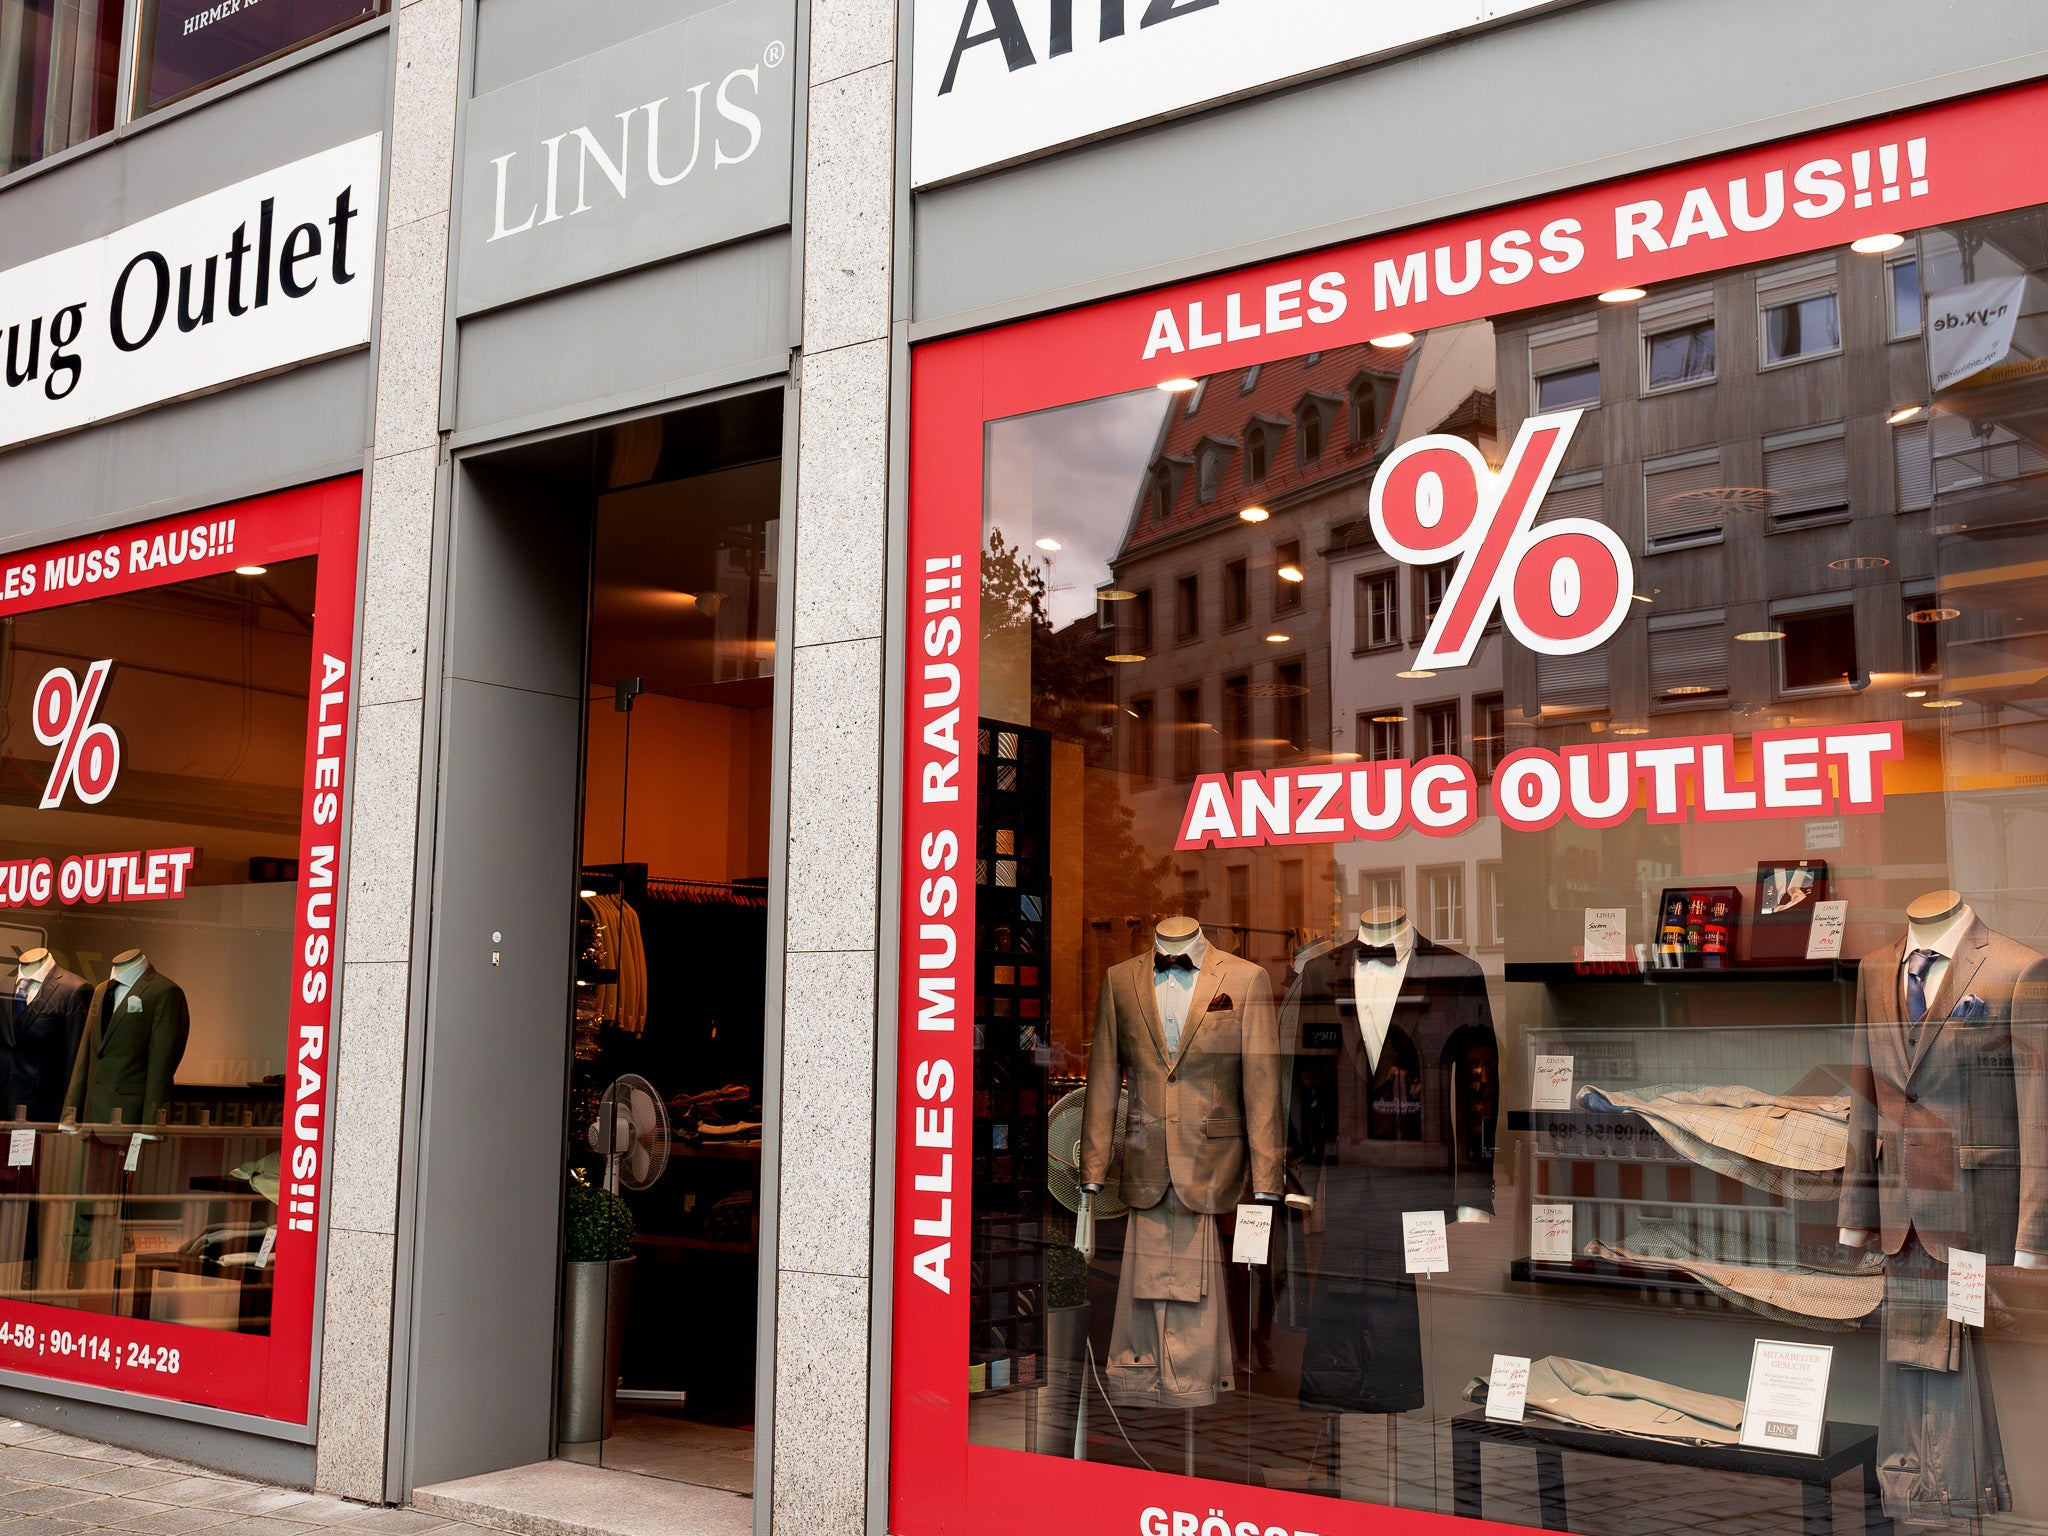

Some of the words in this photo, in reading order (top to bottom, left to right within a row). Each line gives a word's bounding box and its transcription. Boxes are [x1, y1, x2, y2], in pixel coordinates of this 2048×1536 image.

[0, 301, 88, 401] ug
[109, 185, 358, 353] Outlet
[1142, 272, 1347, 360] ALLES
[1373, 217, 1584, 311] MUSS
[1615, 137, 1929, 260] RAUS!!!
[0, 563, 37, 601] ES
[43, 545, 121, 592] MUSS
[129, 519, 236, 574] RAUS!!!
[313, 653, 346, 826] ALLES
[923, 554, 963, 804] RAUS!!!
[1185, 761, 1471, 843] ANZUG
[1500, 730, 1894, 823] OUTLET
[61, 852, 191, 899] OUTLET
[302, 845, 335, 1005] MUSS
[917, 827, 960, 1032] MUSS
[287, 1025, 325, 1233] RAUS!!!
[913, 1058, 955, 1296] ALLES
[50, 1329, 111, 1362] 90-114
[126, 1342, 181, 1374] 24-28
[1770, 1360, 1813, 1372] GESUCHT
